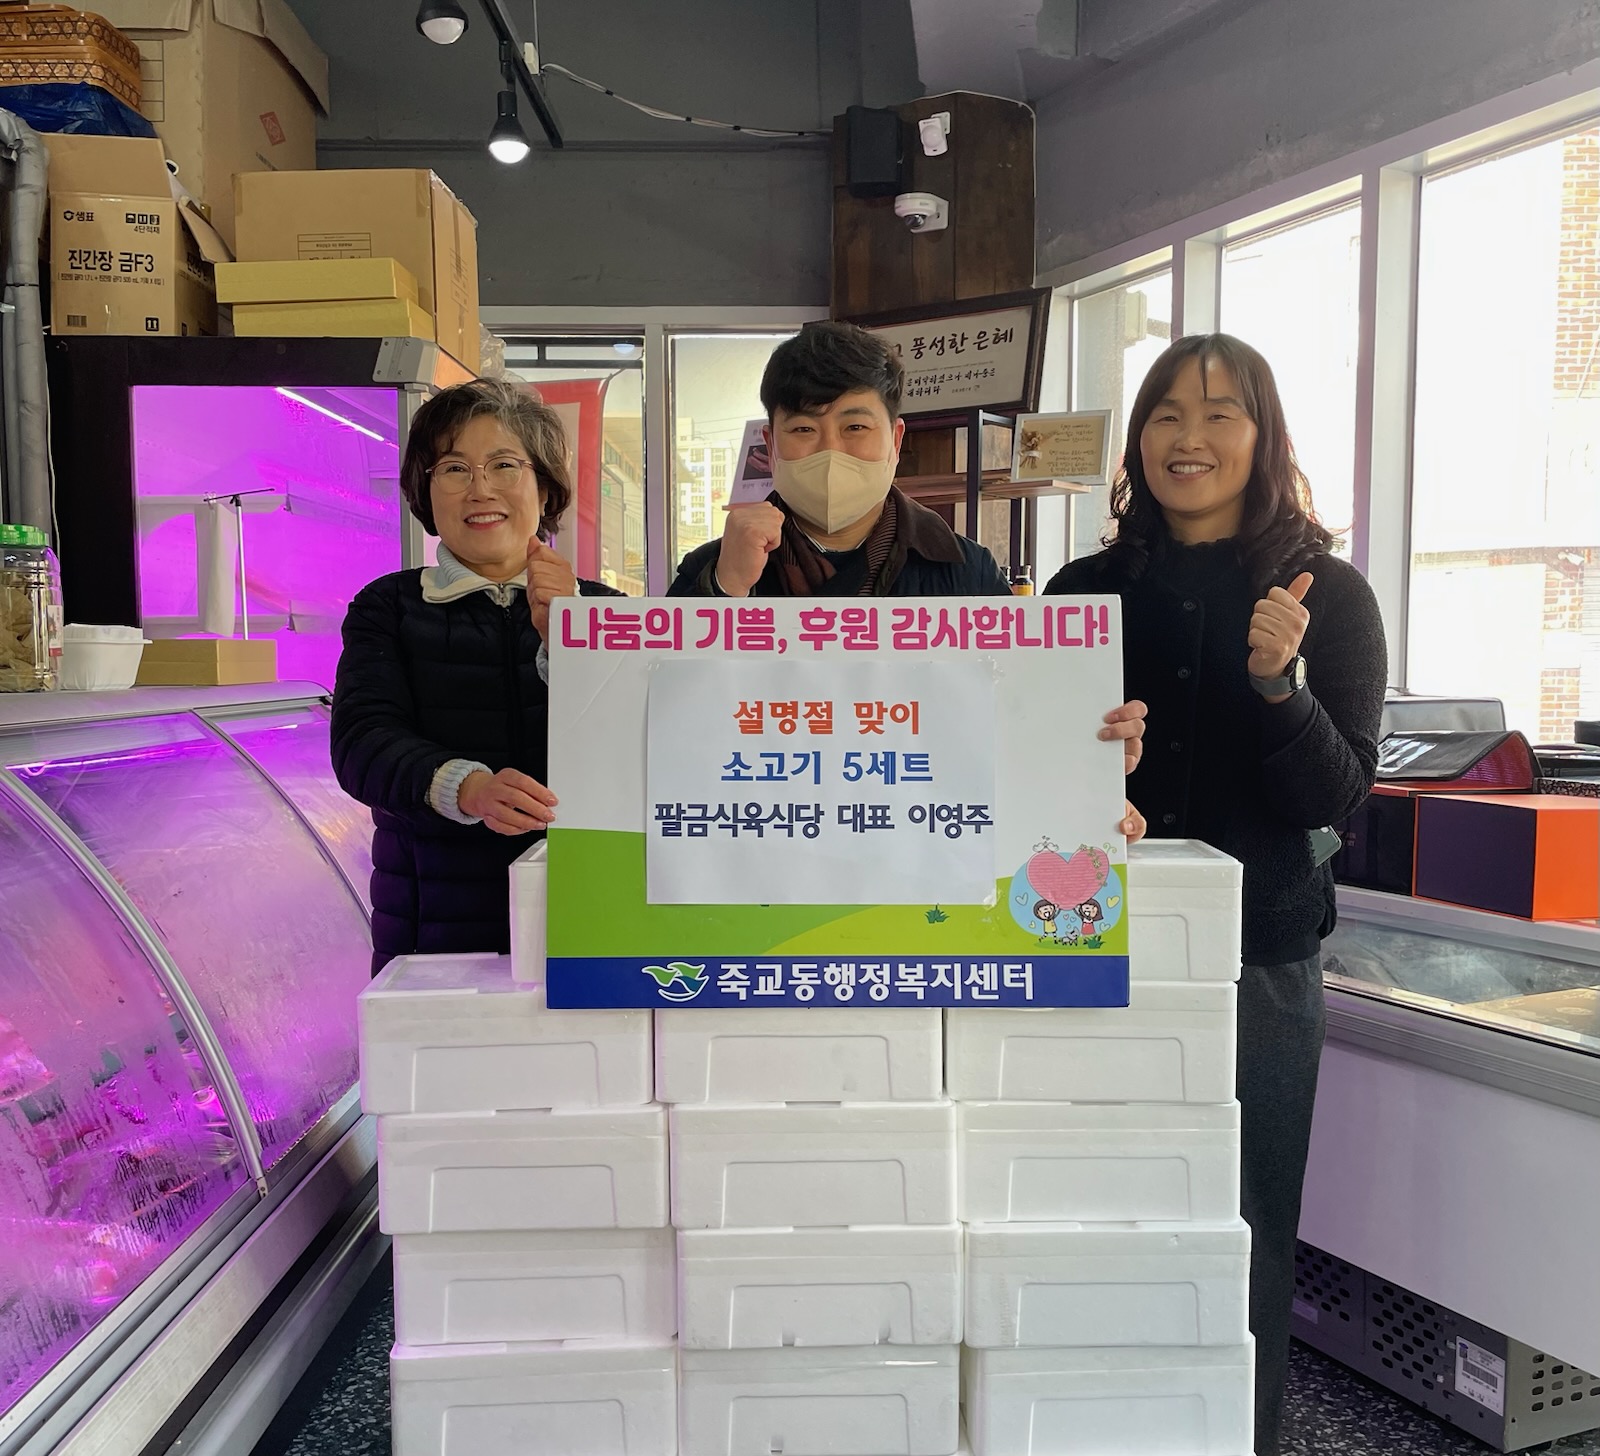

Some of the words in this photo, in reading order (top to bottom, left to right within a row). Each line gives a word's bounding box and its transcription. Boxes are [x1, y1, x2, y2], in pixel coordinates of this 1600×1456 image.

[76, 211, 95, 222] 샘표
[68, 249, 114, 272] 진간장
[118, 252, 154, 273] 금F3
[910, 332, 969, 360] 풍성한
[972, 327, 1014, 351] 은혜
[562, 608, 683, 651] 나눔의
[695, 608, 788, 653] 기쁨,
[798, 608, 879, 651] 후원
[891, 605, 1109, 649] 감사합니다!
[733, 700, 833, 735] 설명절
[853, 701, 920, 734] 맞이
[721, 752, 822, 785] 소고기
[842, 751, 933, 785] 5세트
[654, 802, 825, 839] 팔금식육식당
[837, 803, 895, 834] 대표
[908, 803, 994, 839] 이영주
[716, 962, 1034, 1002] 죽교동행정복지센터
